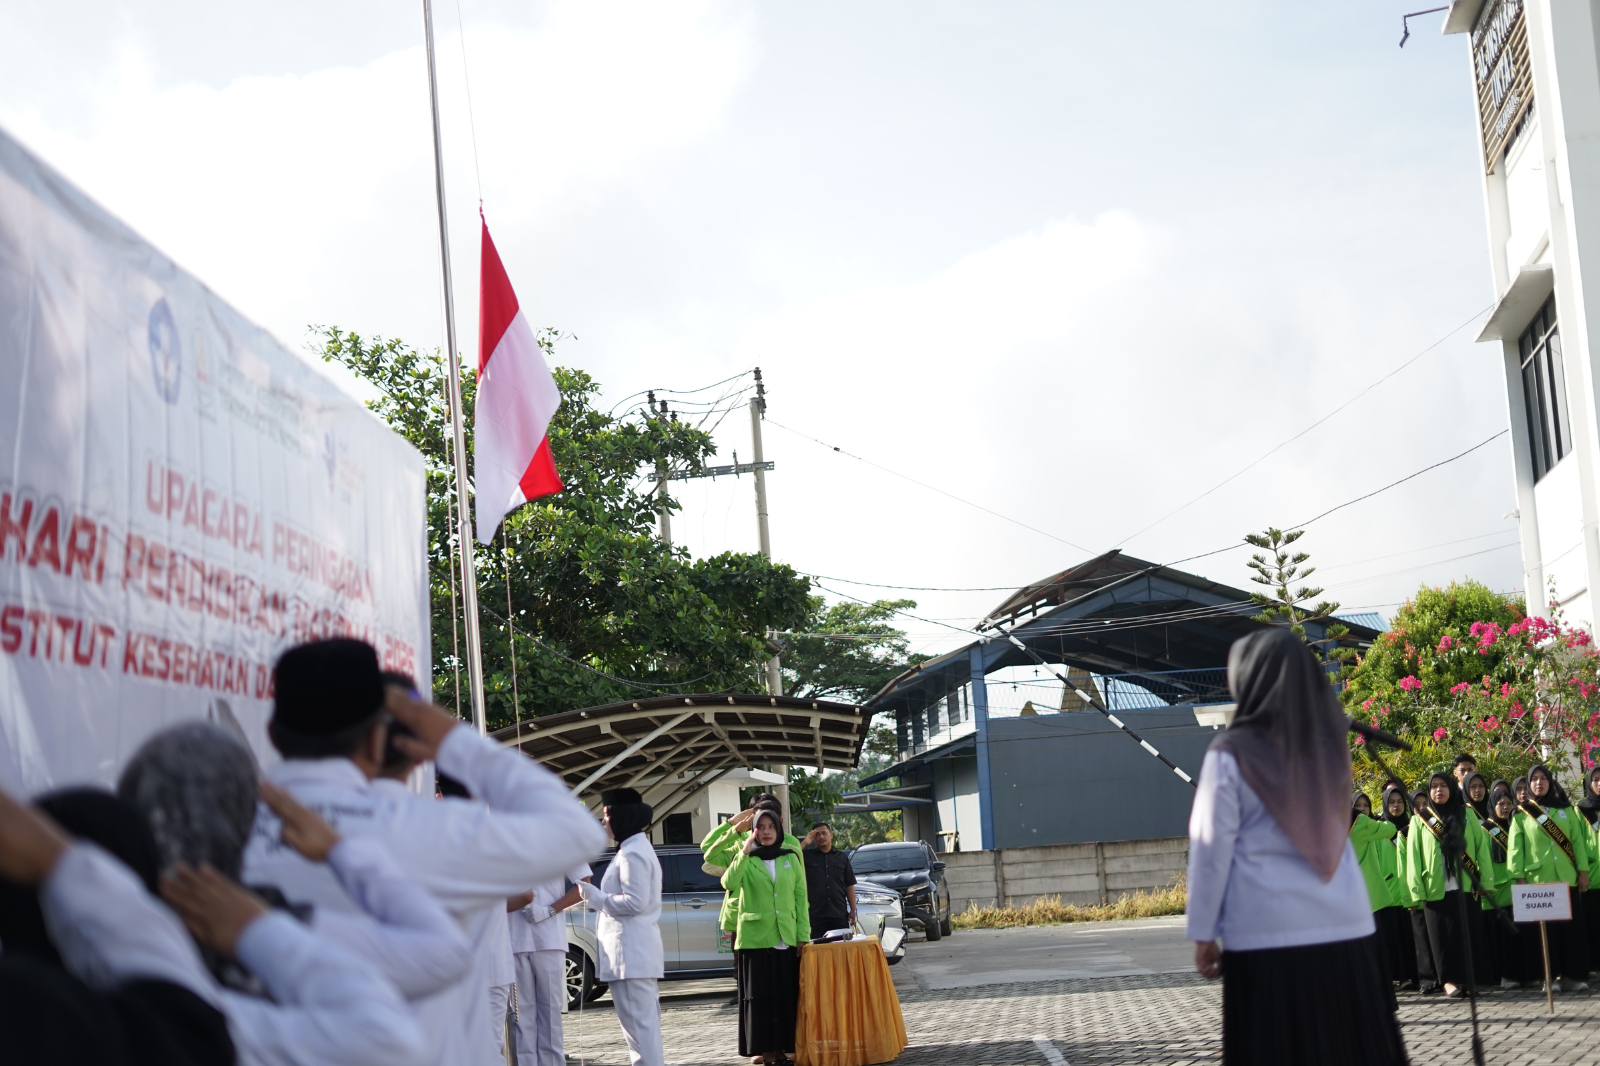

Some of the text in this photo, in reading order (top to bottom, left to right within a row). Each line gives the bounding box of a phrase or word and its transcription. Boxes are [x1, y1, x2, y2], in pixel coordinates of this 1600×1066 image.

[0, 492, 108, 584] HARI
[146, 459, 264, 559] UPACARA
[273, 521, 374, 607] PERINGATAN
[123, 631, 250, 696] KESEHATAN
[1521, 891, 1555, 899] PADUAN
